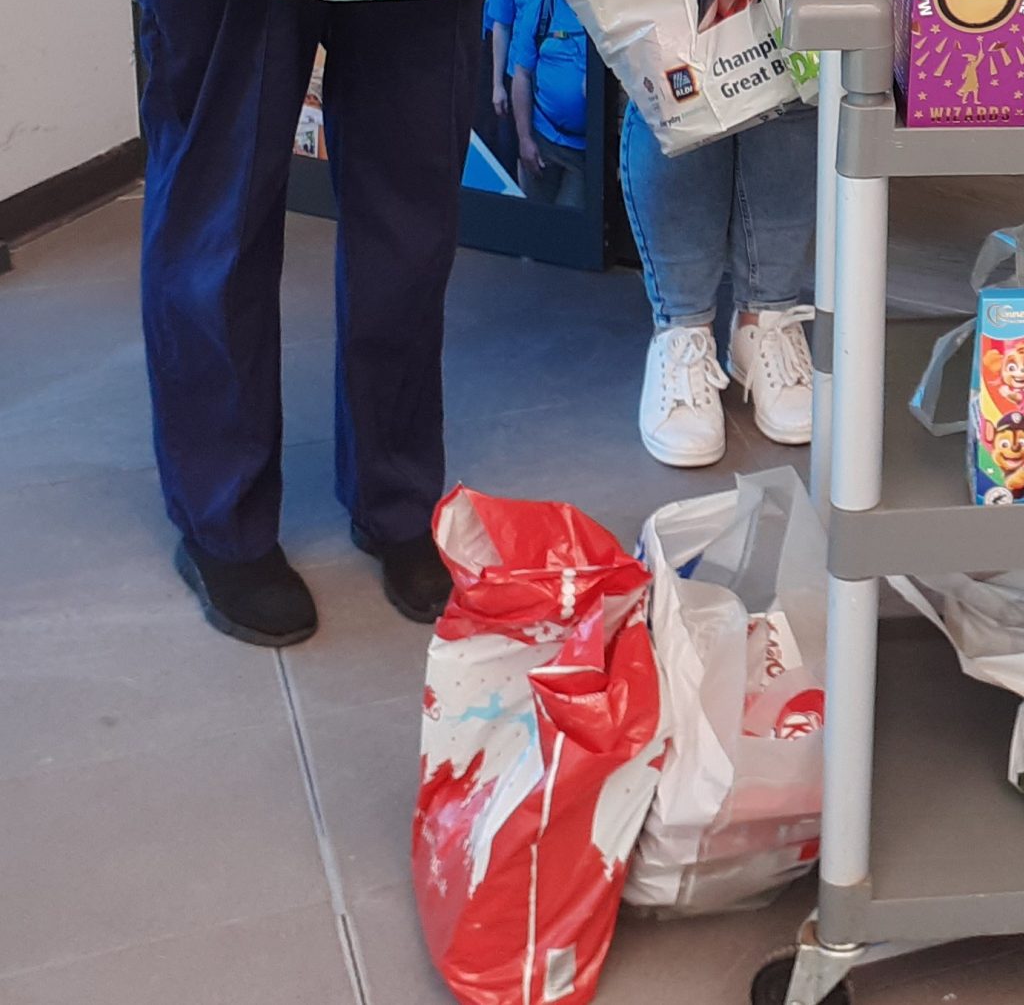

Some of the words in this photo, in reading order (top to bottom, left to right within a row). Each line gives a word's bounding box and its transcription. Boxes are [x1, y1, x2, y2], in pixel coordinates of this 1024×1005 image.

[720, 66, 771, 99] Great
[675, 85, 694, 98] ALDI
[929, 106, 1011, 123] WIZARDS
